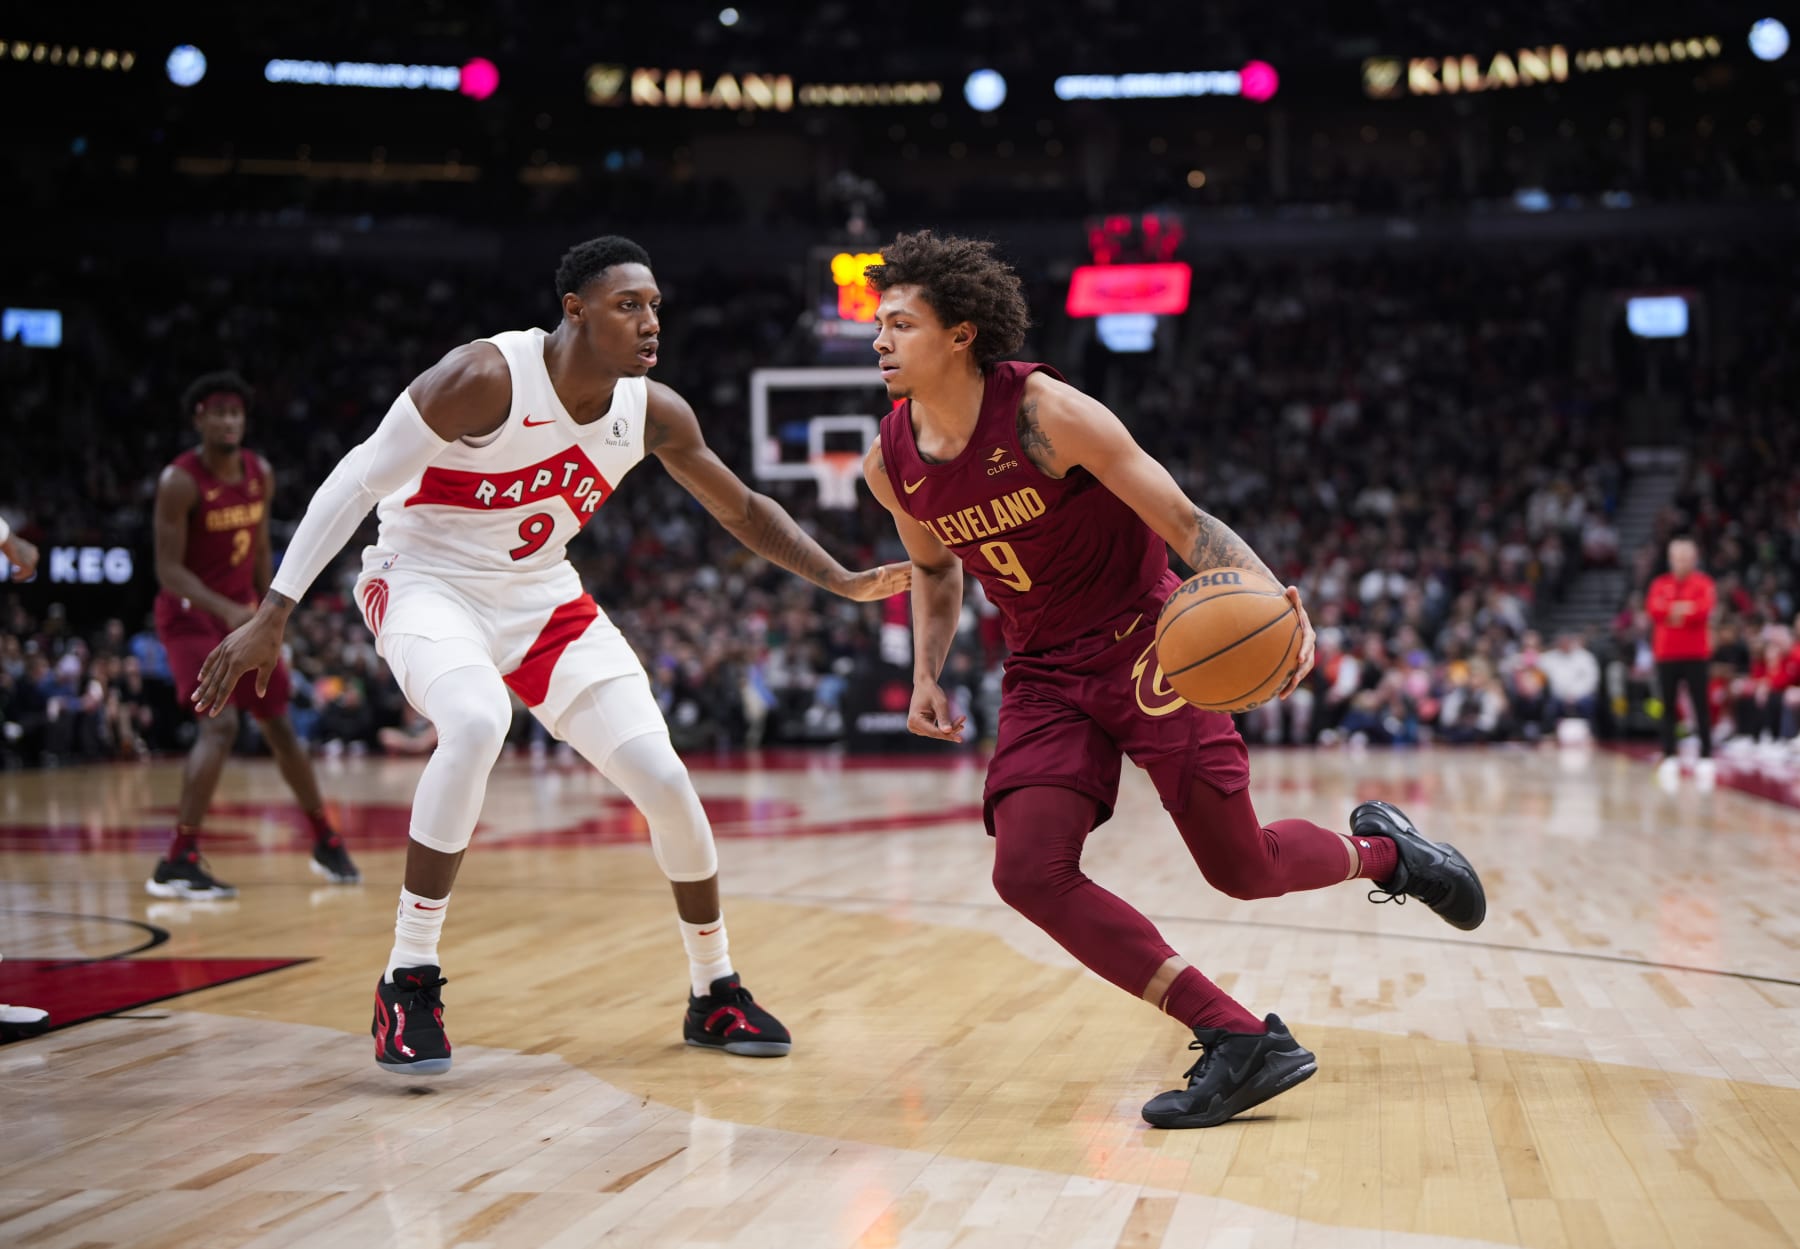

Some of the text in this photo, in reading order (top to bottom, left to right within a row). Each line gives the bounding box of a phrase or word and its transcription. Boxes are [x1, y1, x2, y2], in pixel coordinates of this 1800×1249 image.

[631, 67, 794, 112] KILANI
[1408, 44, 1569, 95] KILANI
[605, 438, 617, 446] Sun
[987, 460, 1018, 475] CLIFFS
[509, 512, 555, 561] 9
[49, 546, 133, 584] KEG
[979, 541, 1032, 592] 9
